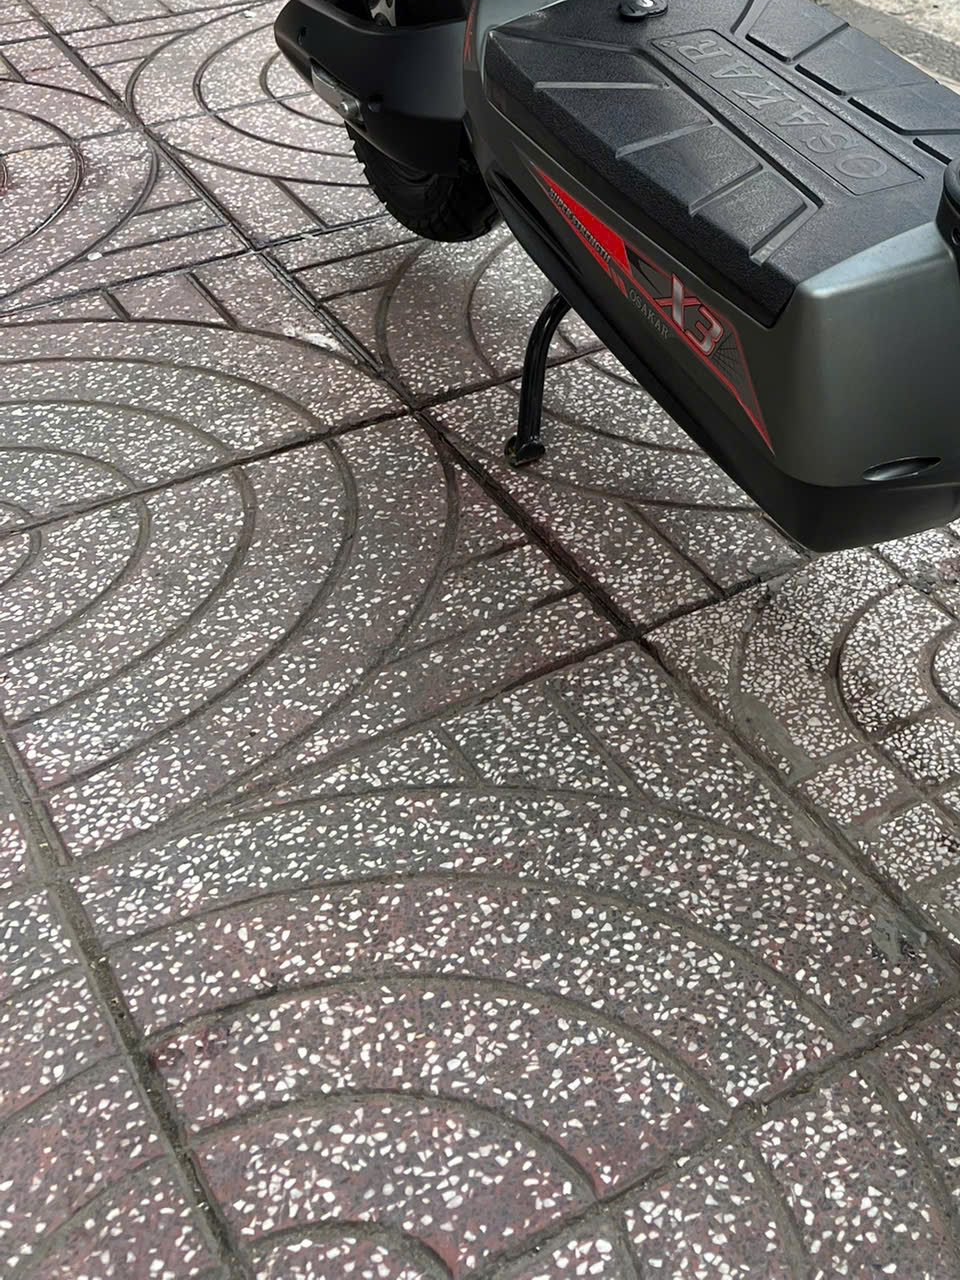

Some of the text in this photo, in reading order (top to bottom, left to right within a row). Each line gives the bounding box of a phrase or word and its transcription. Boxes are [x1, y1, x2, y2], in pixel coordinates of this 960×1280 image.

[674, 37, 889, 180] OSAKAR
[629, 288, 670, 340] OSAKAR
[653, 273, 725, 357] X3
